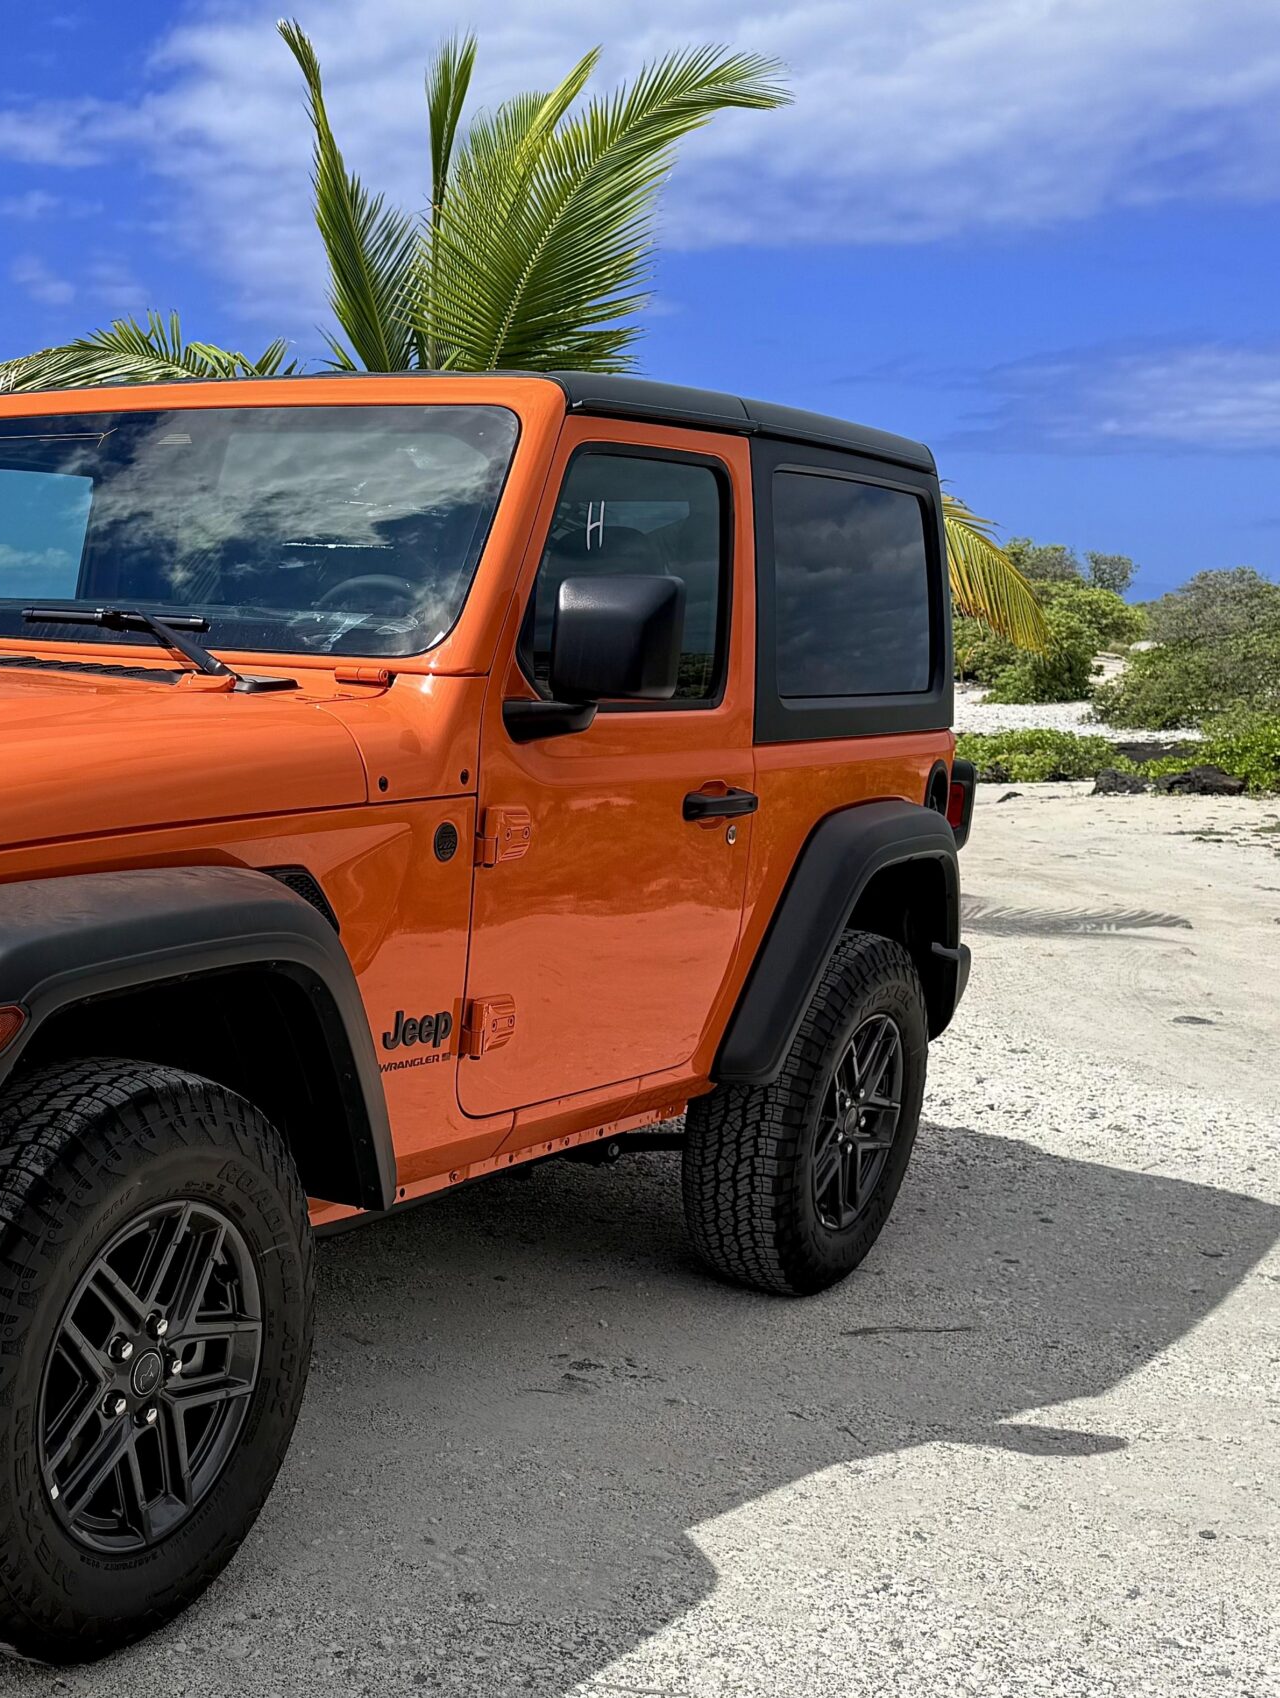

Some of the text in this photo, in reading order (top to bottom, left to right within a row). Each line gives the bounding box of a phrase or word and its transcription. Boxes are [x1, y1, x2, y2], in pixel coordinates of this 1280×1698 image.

[587, 500, 605, 550] H
[382, 1010, 453, 1050] Jeep
[378, 1054, 440, 1073] WRANGLER
[217, 1159, 300, 1304] ROADIAN
[13, 1405, 79, 1596] NEXEN
